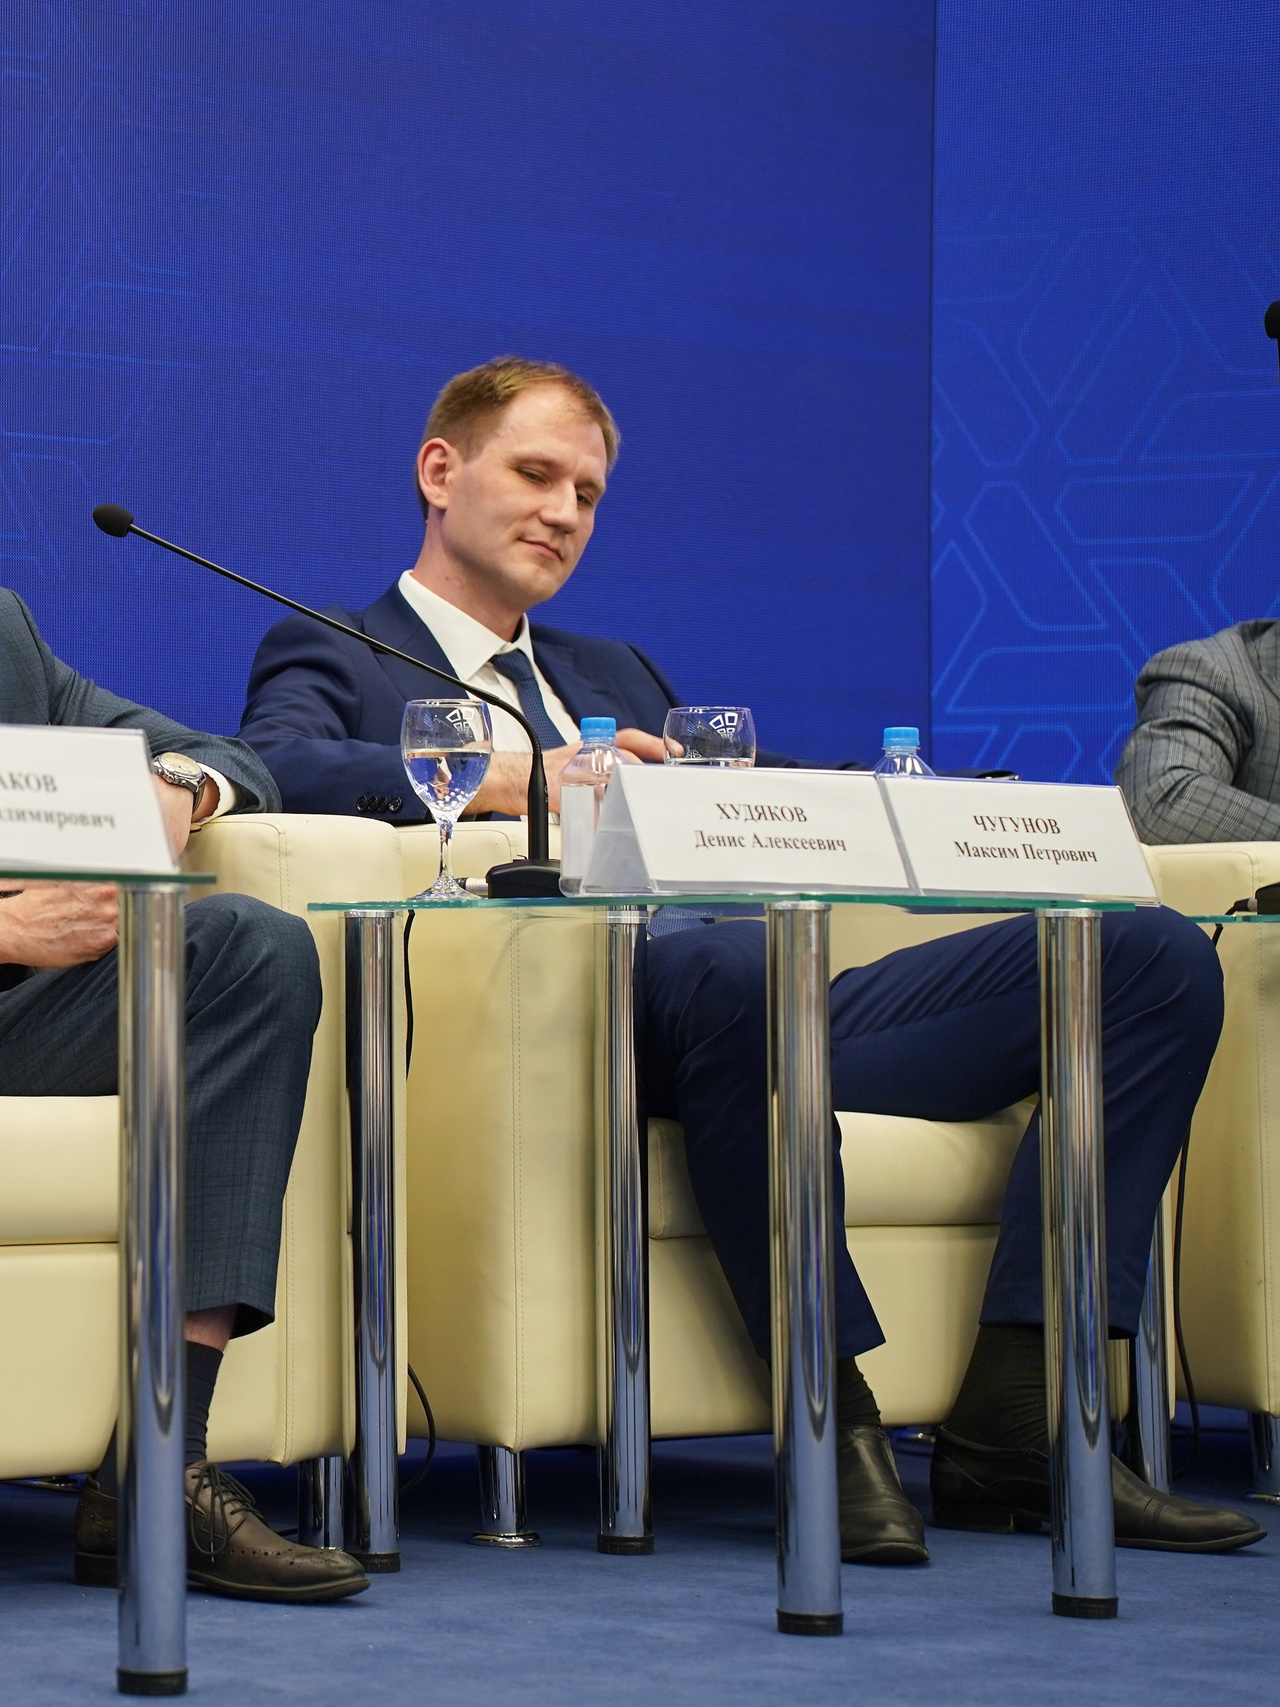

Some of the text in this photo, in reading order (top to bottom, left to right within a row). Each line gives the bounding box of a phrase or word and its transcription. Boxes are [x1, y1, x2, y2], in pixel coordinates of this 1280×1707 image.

[715, 803, 808, 822] ХУДЯКОВ
[972, 815, 1061, 834] ЧУГУНОВ
[694, 830, 848, 851] Денис Алексеевич
[953, 841, 1098, 865] Максим Петрович
